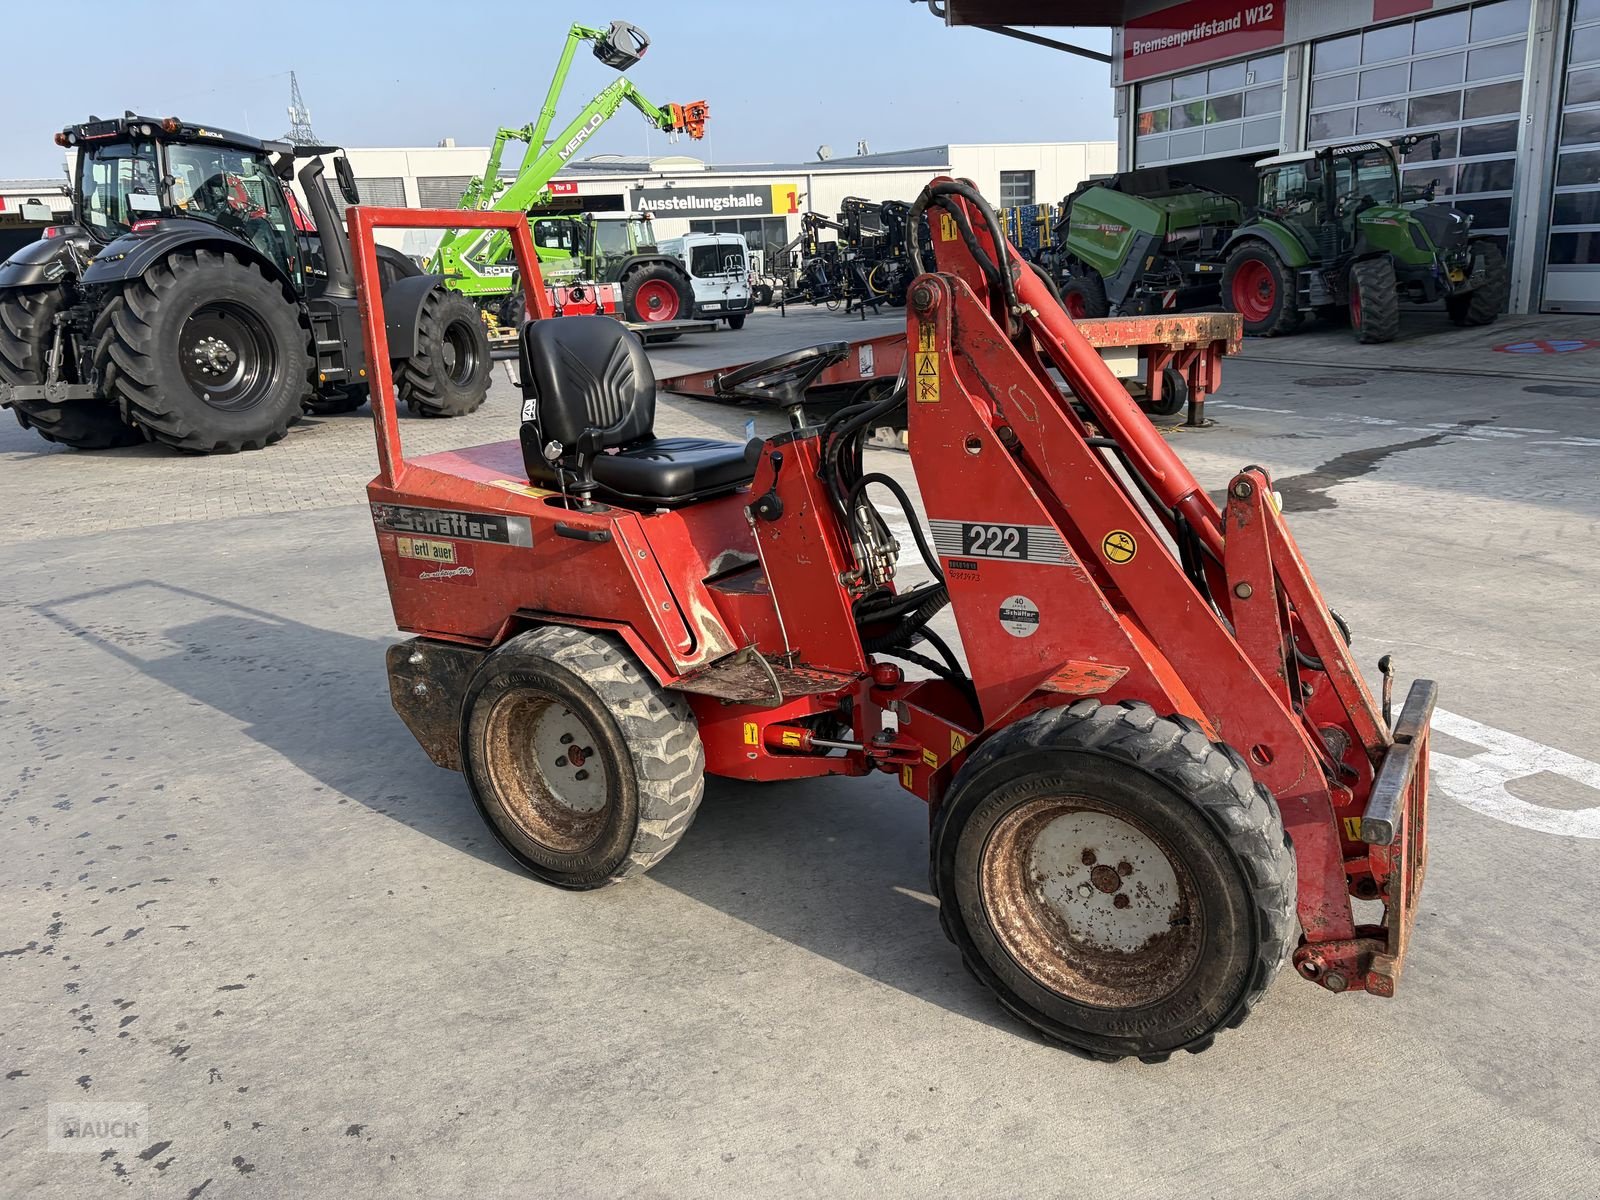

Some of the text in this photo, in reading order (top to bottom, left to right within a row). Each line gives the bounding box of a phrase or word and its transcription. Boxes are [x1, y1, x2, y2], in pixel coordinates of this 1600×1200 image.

[1132, 3, 1274, 56] Bremsenprüfstand W12
[558, 113, 604, 160] MERLO
[554, 183, 565, 191] Tor
[638, 192, 799, 214] Ausstellungshalle 1
[969, 525, 1020, 558] 222
[1014, 597, 1024, 605] 40
